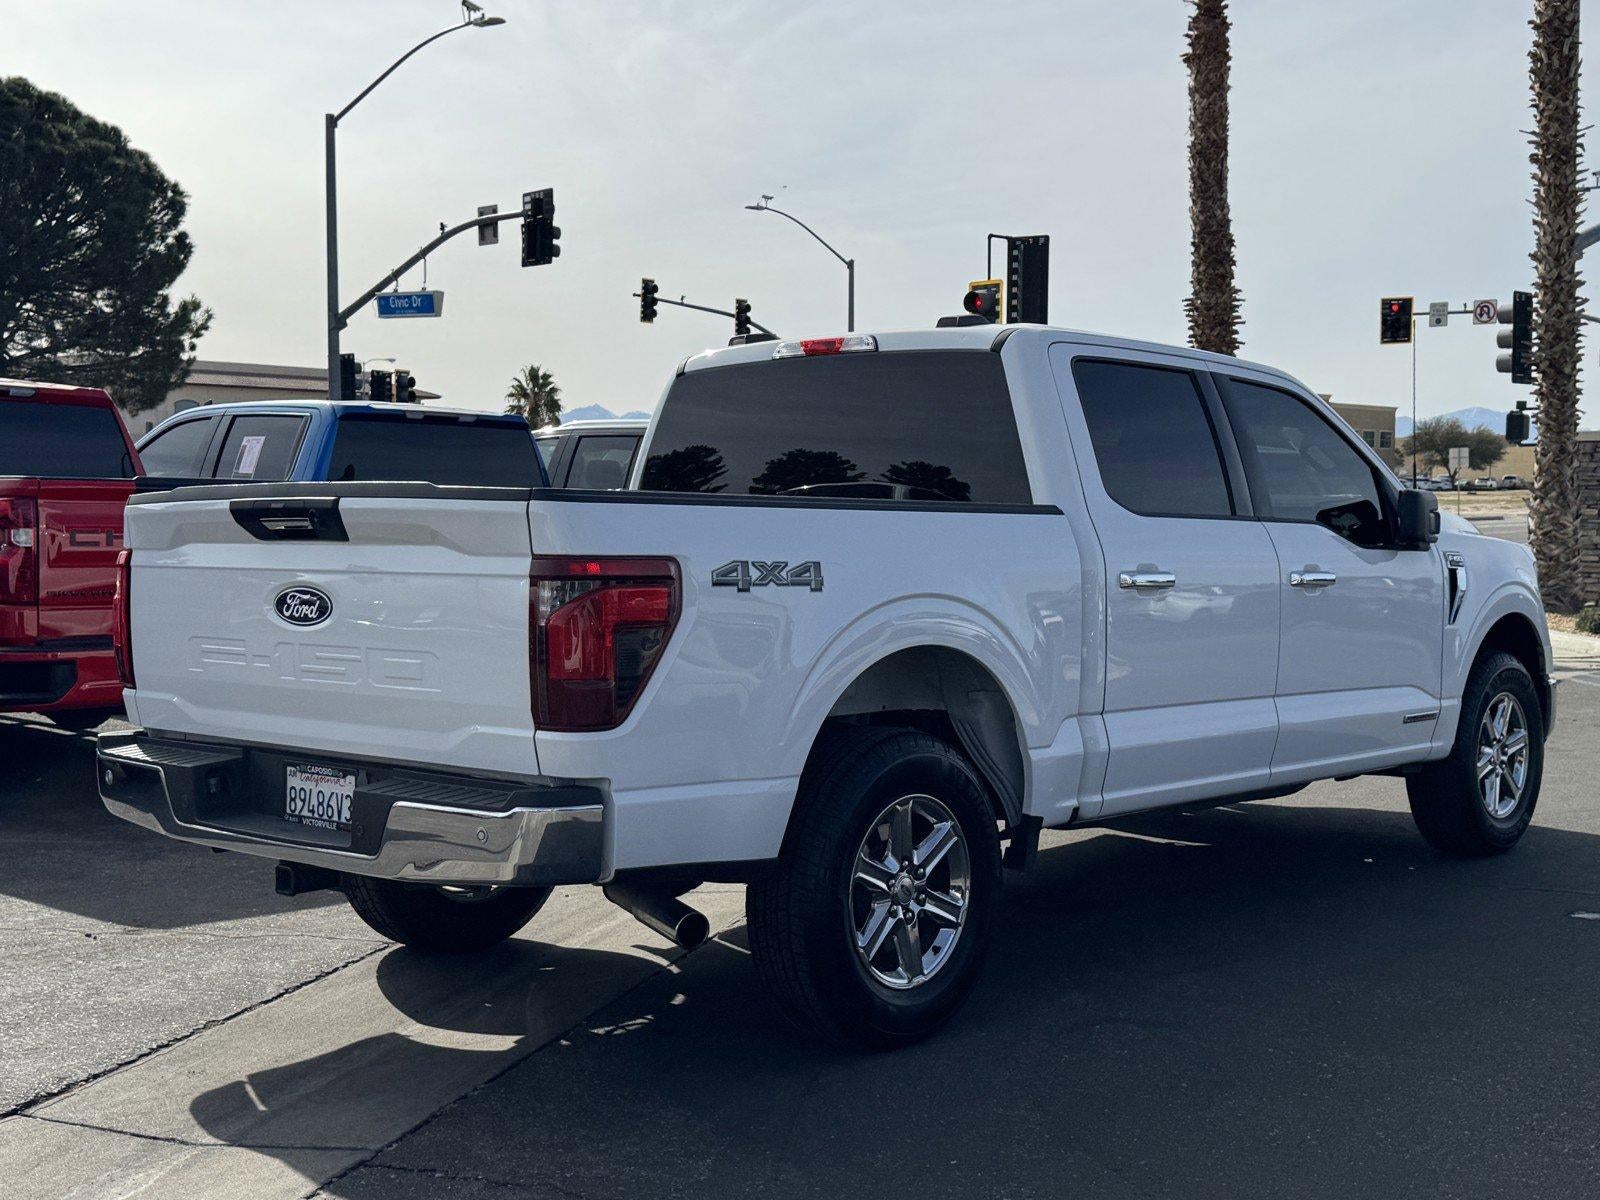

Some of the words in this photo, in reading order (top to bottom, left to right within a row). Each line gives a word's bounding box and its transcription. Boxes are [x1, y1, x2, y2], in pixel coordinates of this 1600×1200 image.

[390, 296, 410, 308] Civic
[411, 295, 422, 307] Dr
[283, 592, 320, 619] Ford
[185, 636, 441, 692] F-150
[307, 765, 333, 776] CAPOSIO
[300, 772, 345, 788] California
[289, 785, 353, 823] 89486V3
[302, 817, 337, 830] VICTORVILLE
